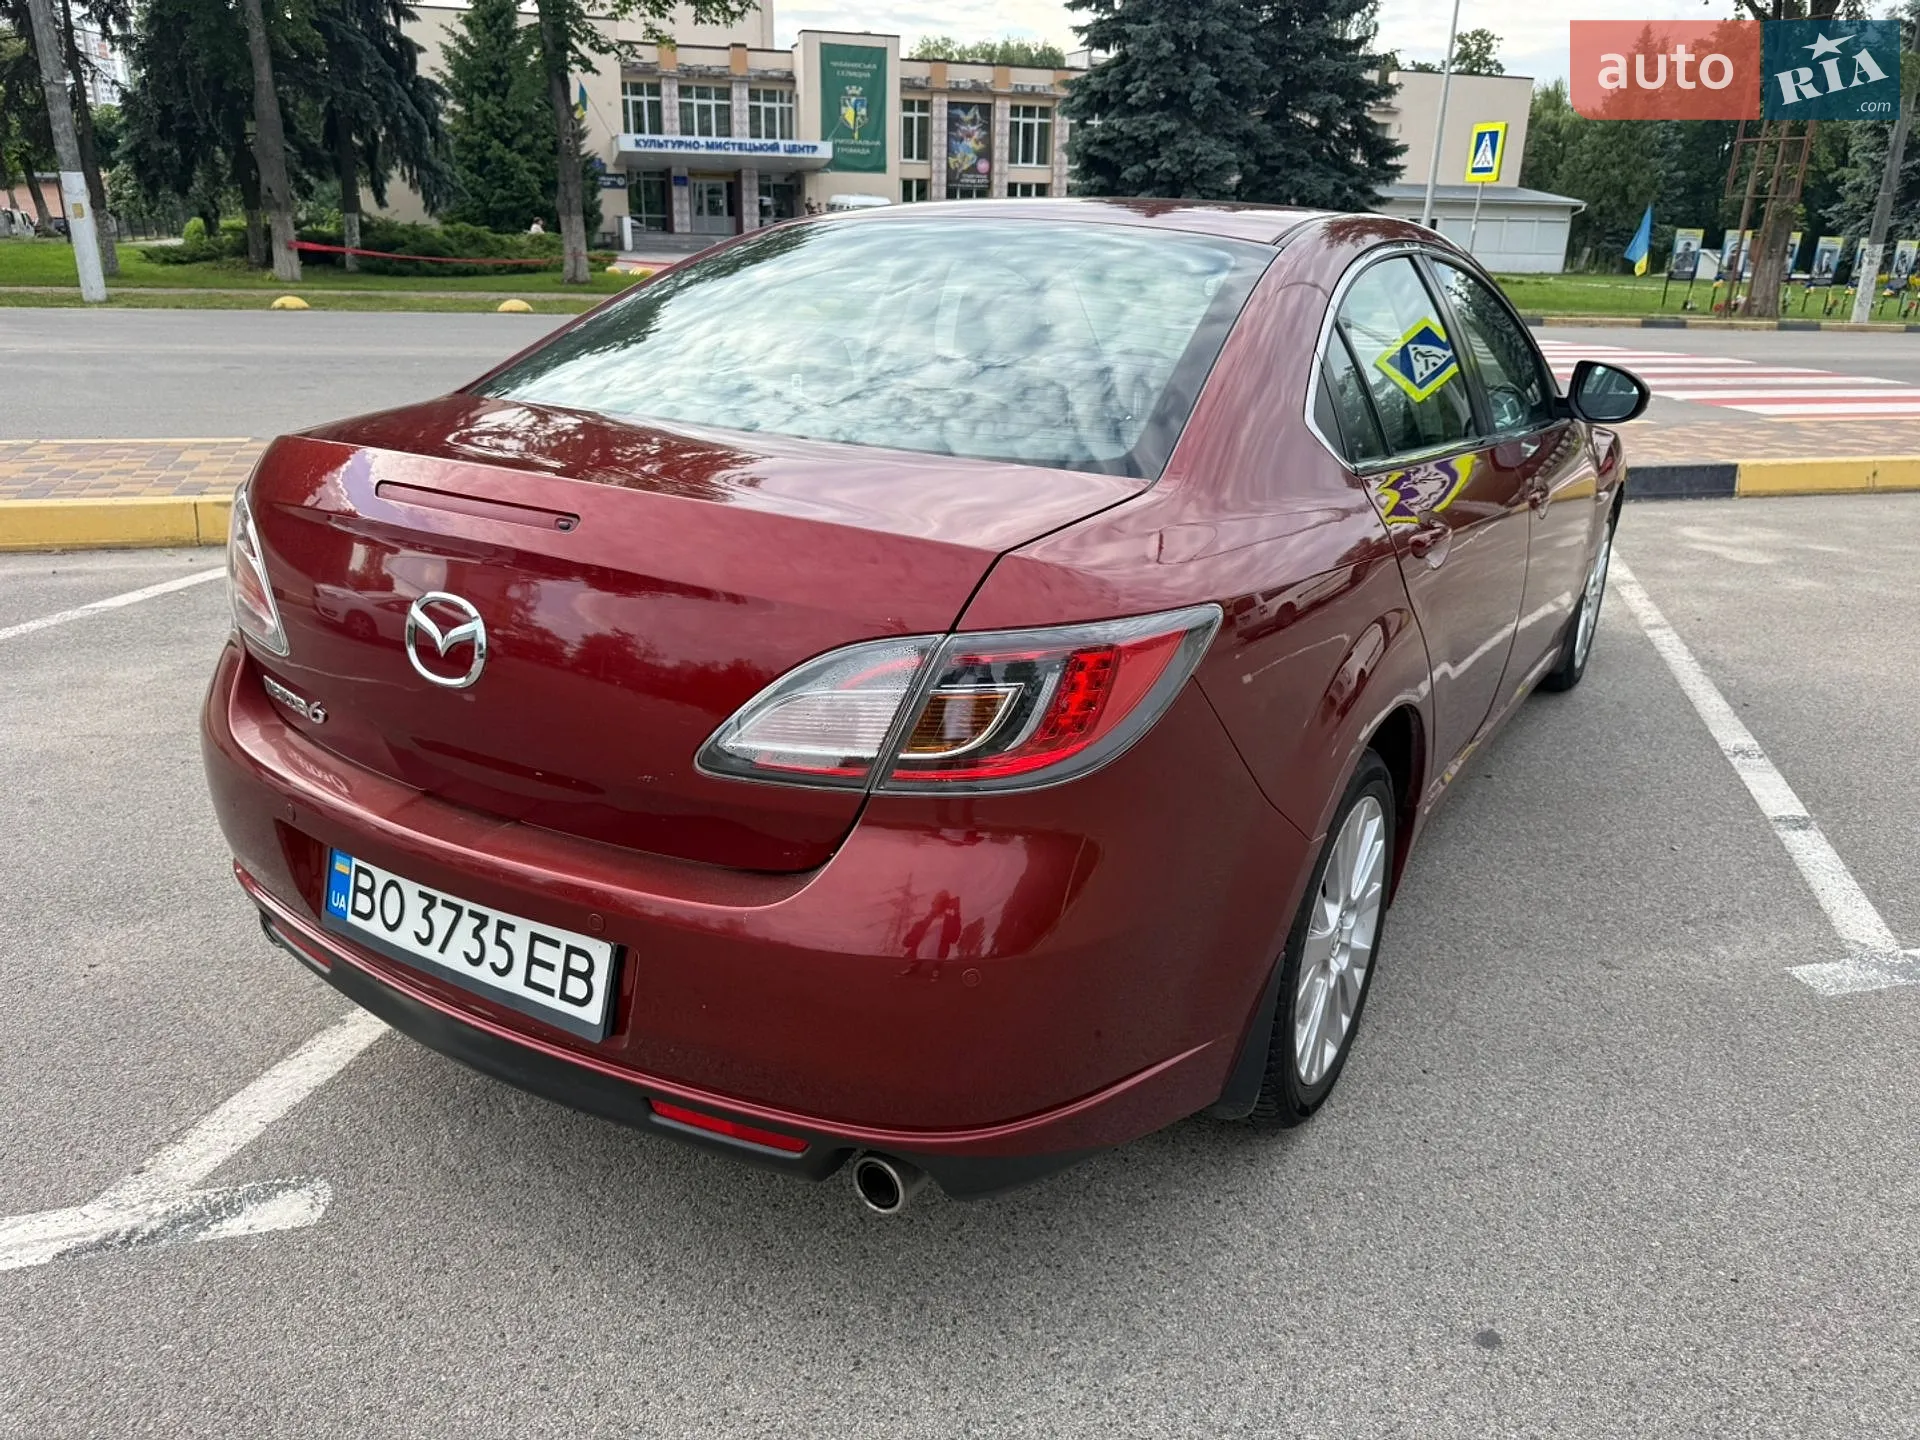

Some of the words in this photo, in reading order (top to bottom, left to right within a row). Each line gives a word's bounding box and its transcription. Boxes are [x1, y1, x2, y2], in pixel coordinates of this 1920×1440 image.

[634, 138, 780, 153] КУЛЬТУРНО-МИСТЕЦЬКИЙ
[783, 142, 818, 155] ЦЕНТР
[331, 890, 347, 911] UA
[351, 864, 405, 932] BO
[413, 890, 516, 977] 3735
[523, 931, 595, 1008] EB
